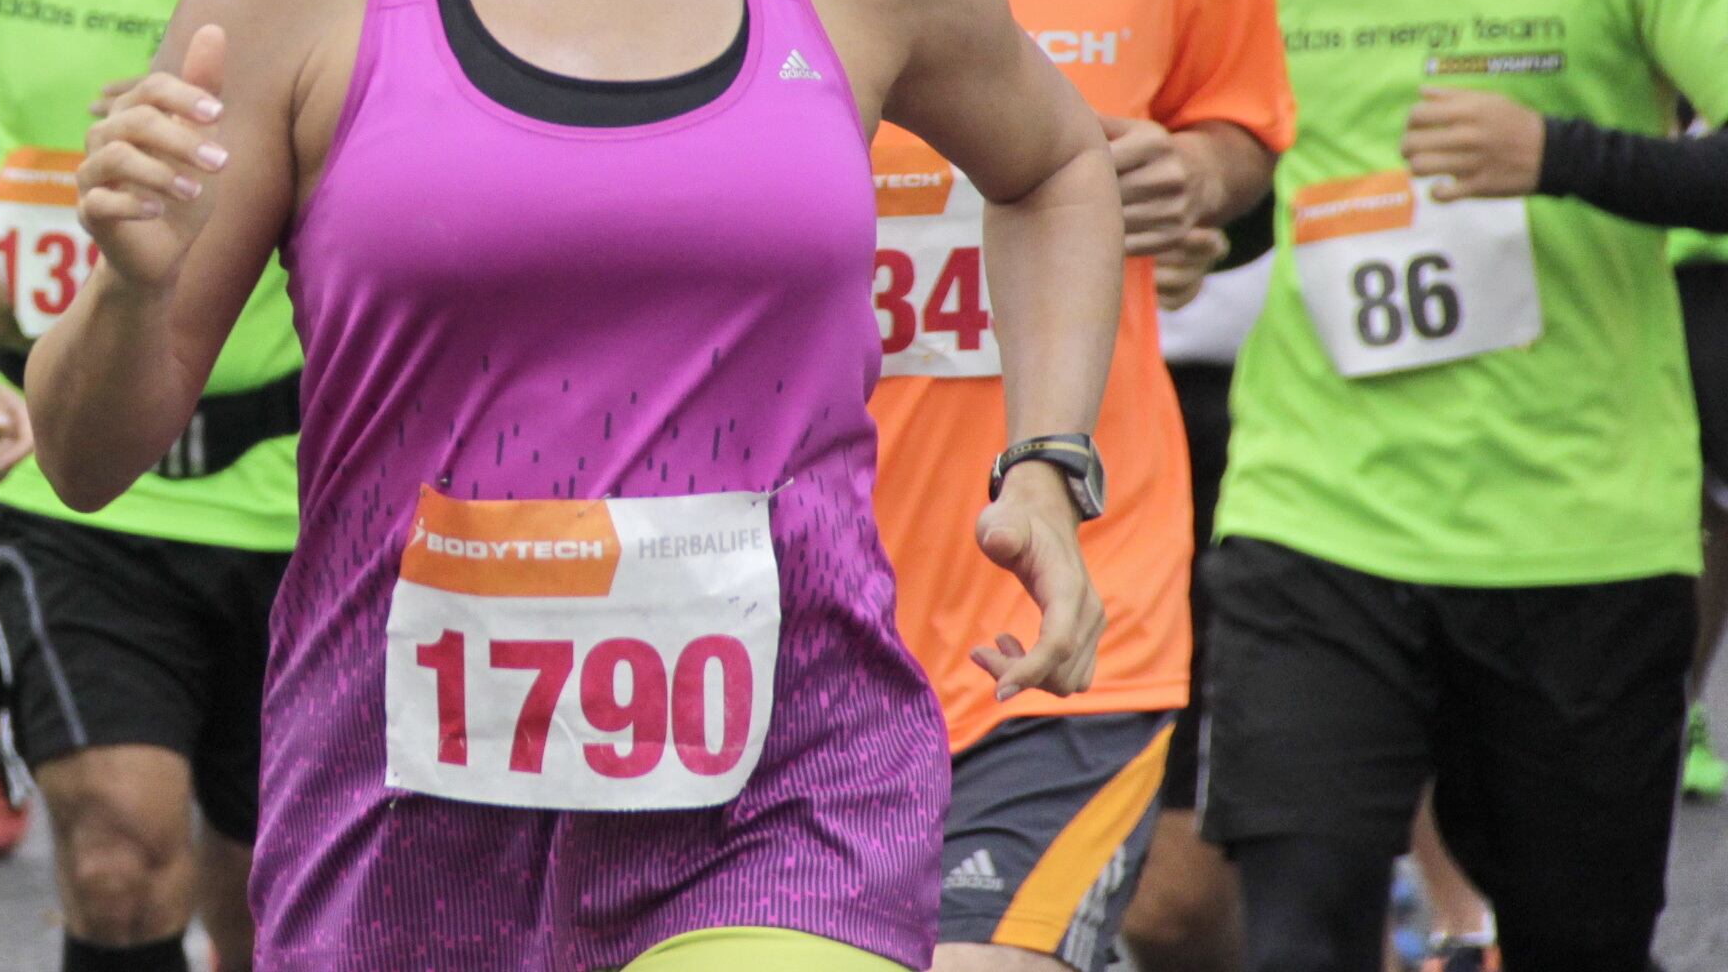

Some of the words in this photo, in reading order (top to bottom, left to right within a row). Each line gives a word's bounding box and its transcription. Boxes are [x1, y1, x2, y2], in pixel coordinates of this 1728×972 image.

[1474, 13, 1565, 41] team
[875, 246, 992, 354] 34
[1352, 255, 1461, 346] 86
[427, 535, 602, 559] BODYTECH
[638, 528, 763, 559] HERBALIFE
[416, 628, 753, 779] 1790
